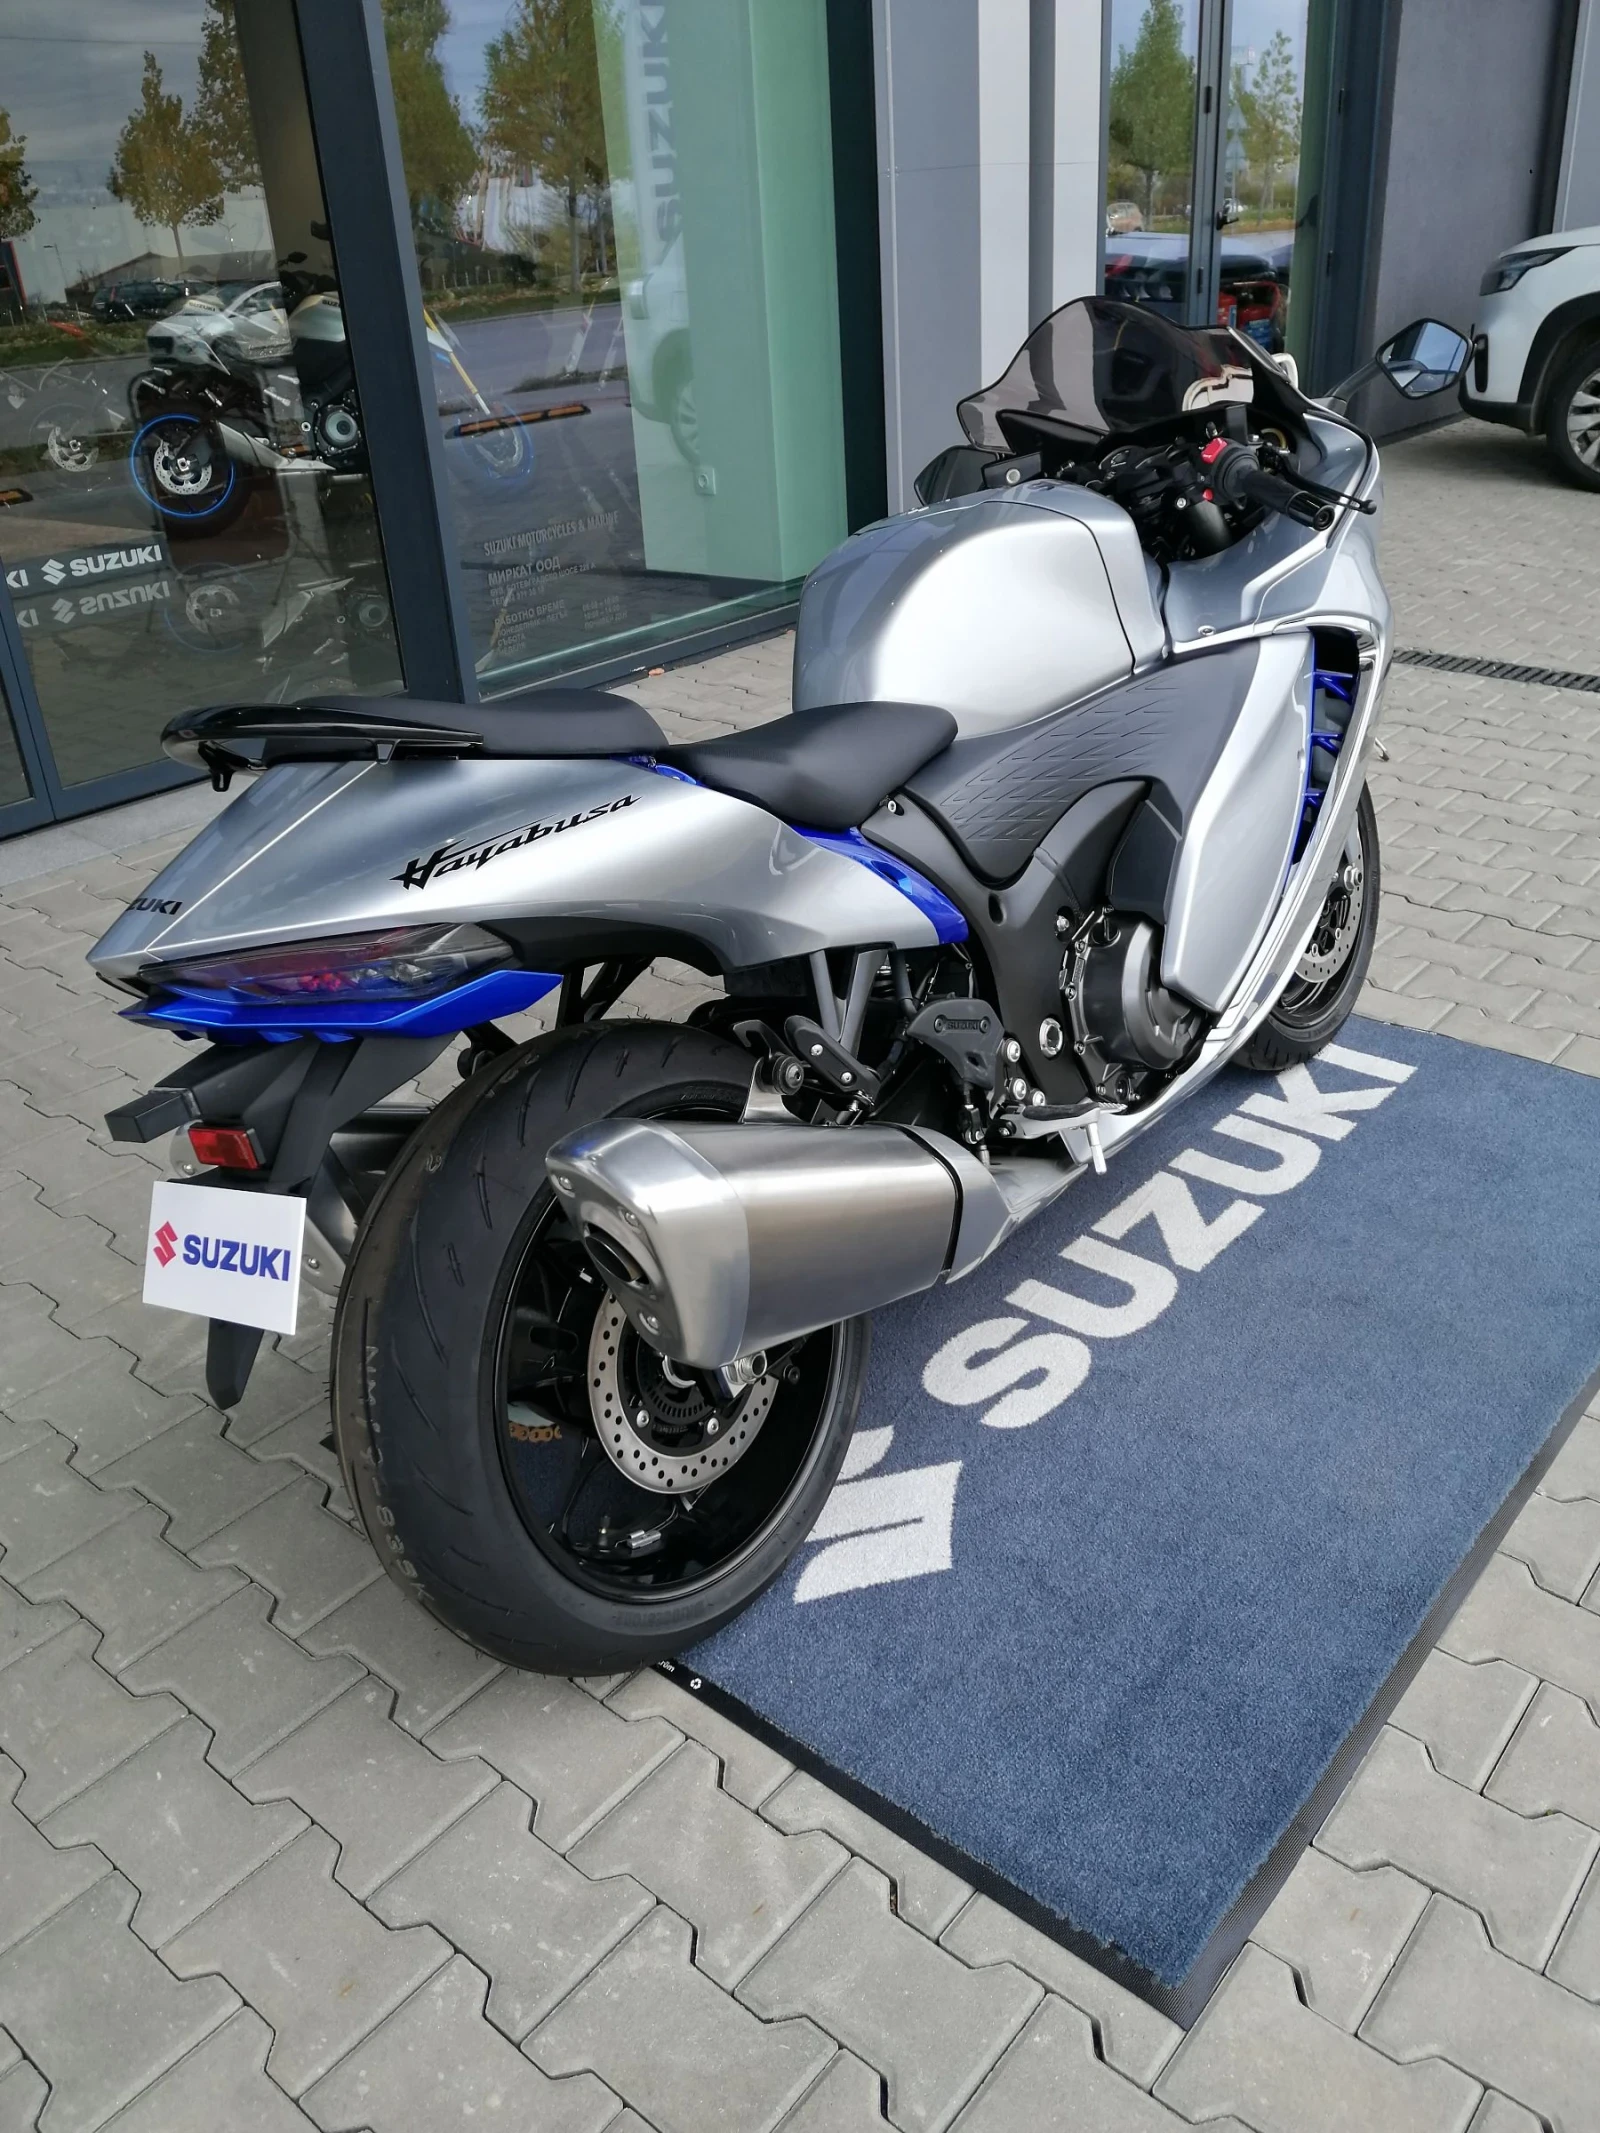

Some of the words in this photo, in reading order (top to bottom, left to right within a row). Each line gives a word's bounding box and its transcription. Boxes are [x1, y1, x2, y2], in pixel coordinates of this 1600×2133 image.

[484, 539, 518, 557] SUZUKI
[518, 522, 577, 548] MOTORCYCLES
[578, 519, 585, 533] &
[587, 510, 619, 530] MARINE
[69, 544, 162, 577] SUZUKI
[488, 562, 533, 587] МИРКАТ
[536, 555, 561, 573] ООД
[536, 599, 565, 615] ВРЕМЕ
[389, 795, 642, 890] Hayabusa
[946, 1020, 979, 1031] SUZUKI
[921, 1042, 1418, 1429] SUZUKI
[182, 1233, 291, 1282] SUZUKI
